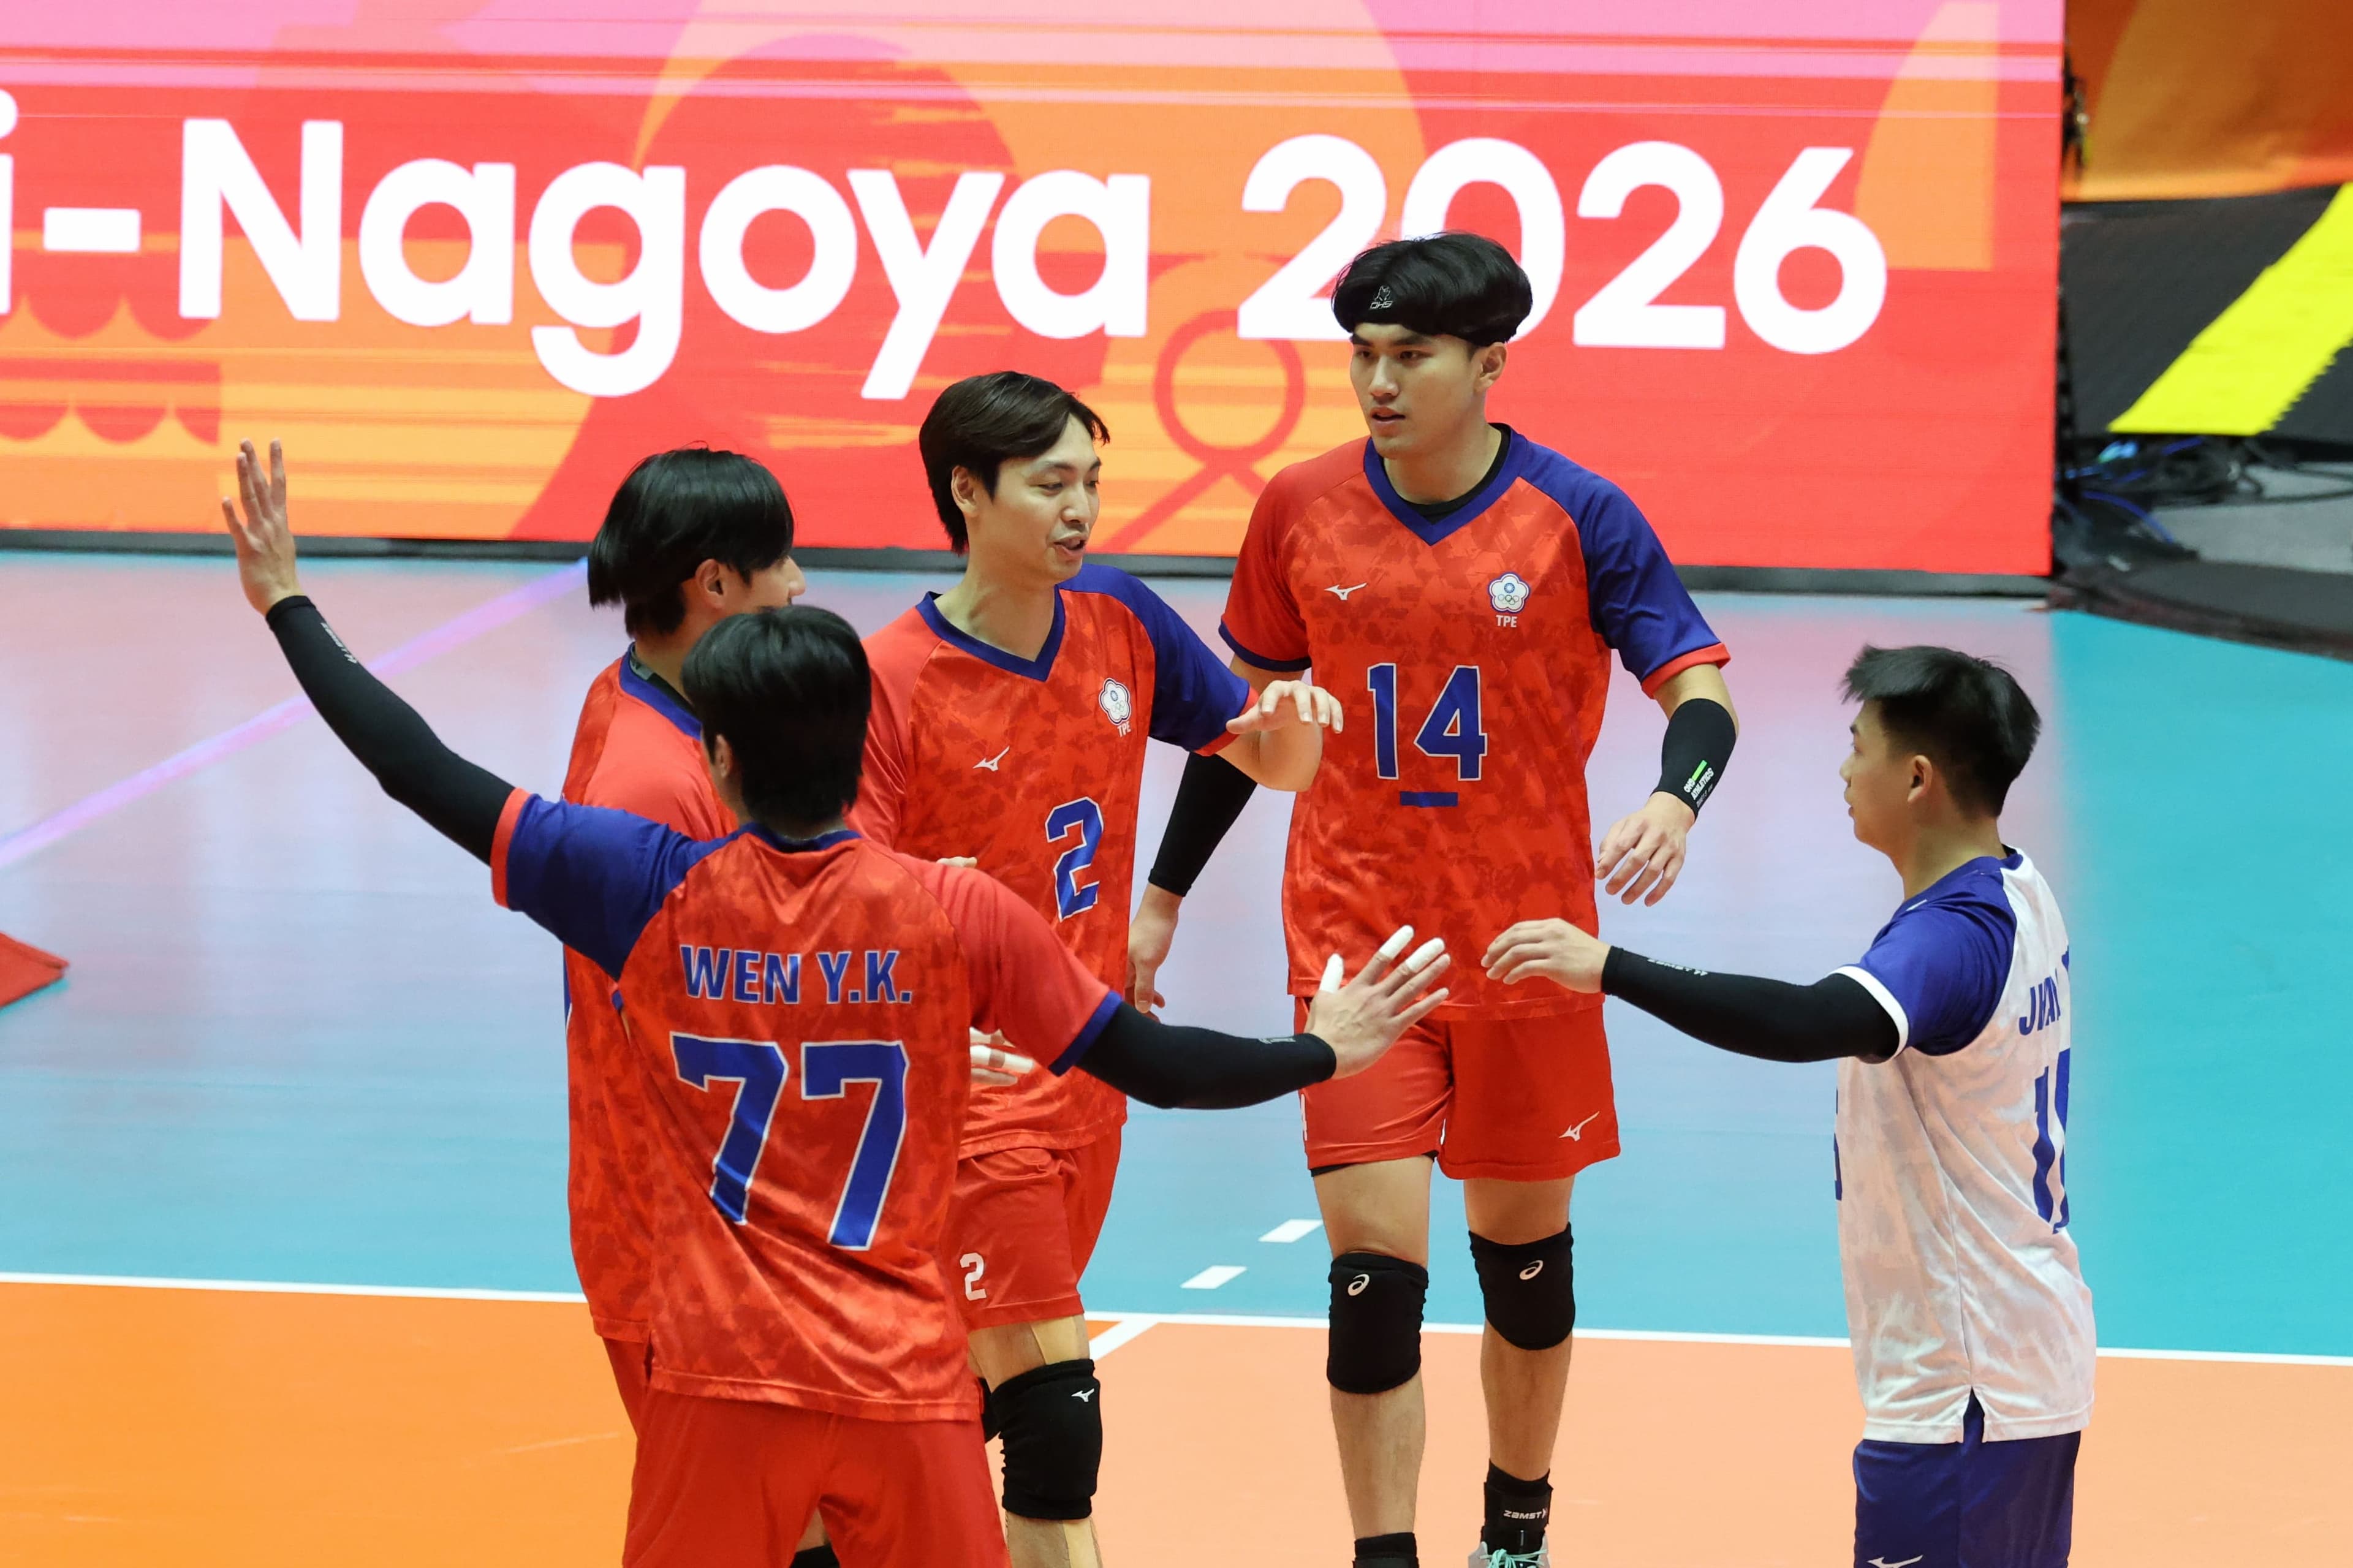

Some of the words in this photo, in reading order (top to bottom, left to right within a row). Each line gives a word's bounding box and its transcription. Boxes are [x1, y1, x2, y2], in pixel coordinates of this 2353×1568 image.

[1238, 134, 1887, 354] 2026
[1496, 615, 1518, 628] TPE
[1117, 721, 1131, 737] TPE
[1367, 662, 1488, 781] 14
[1045, 796, 1104, 923] 2
[680, 944, 801, 1005] WEN
[816, 950, 912, 1004] Y.K.
[669, 1031, 910, 1251] 77
[960, 1252, 987, 1301] 2
